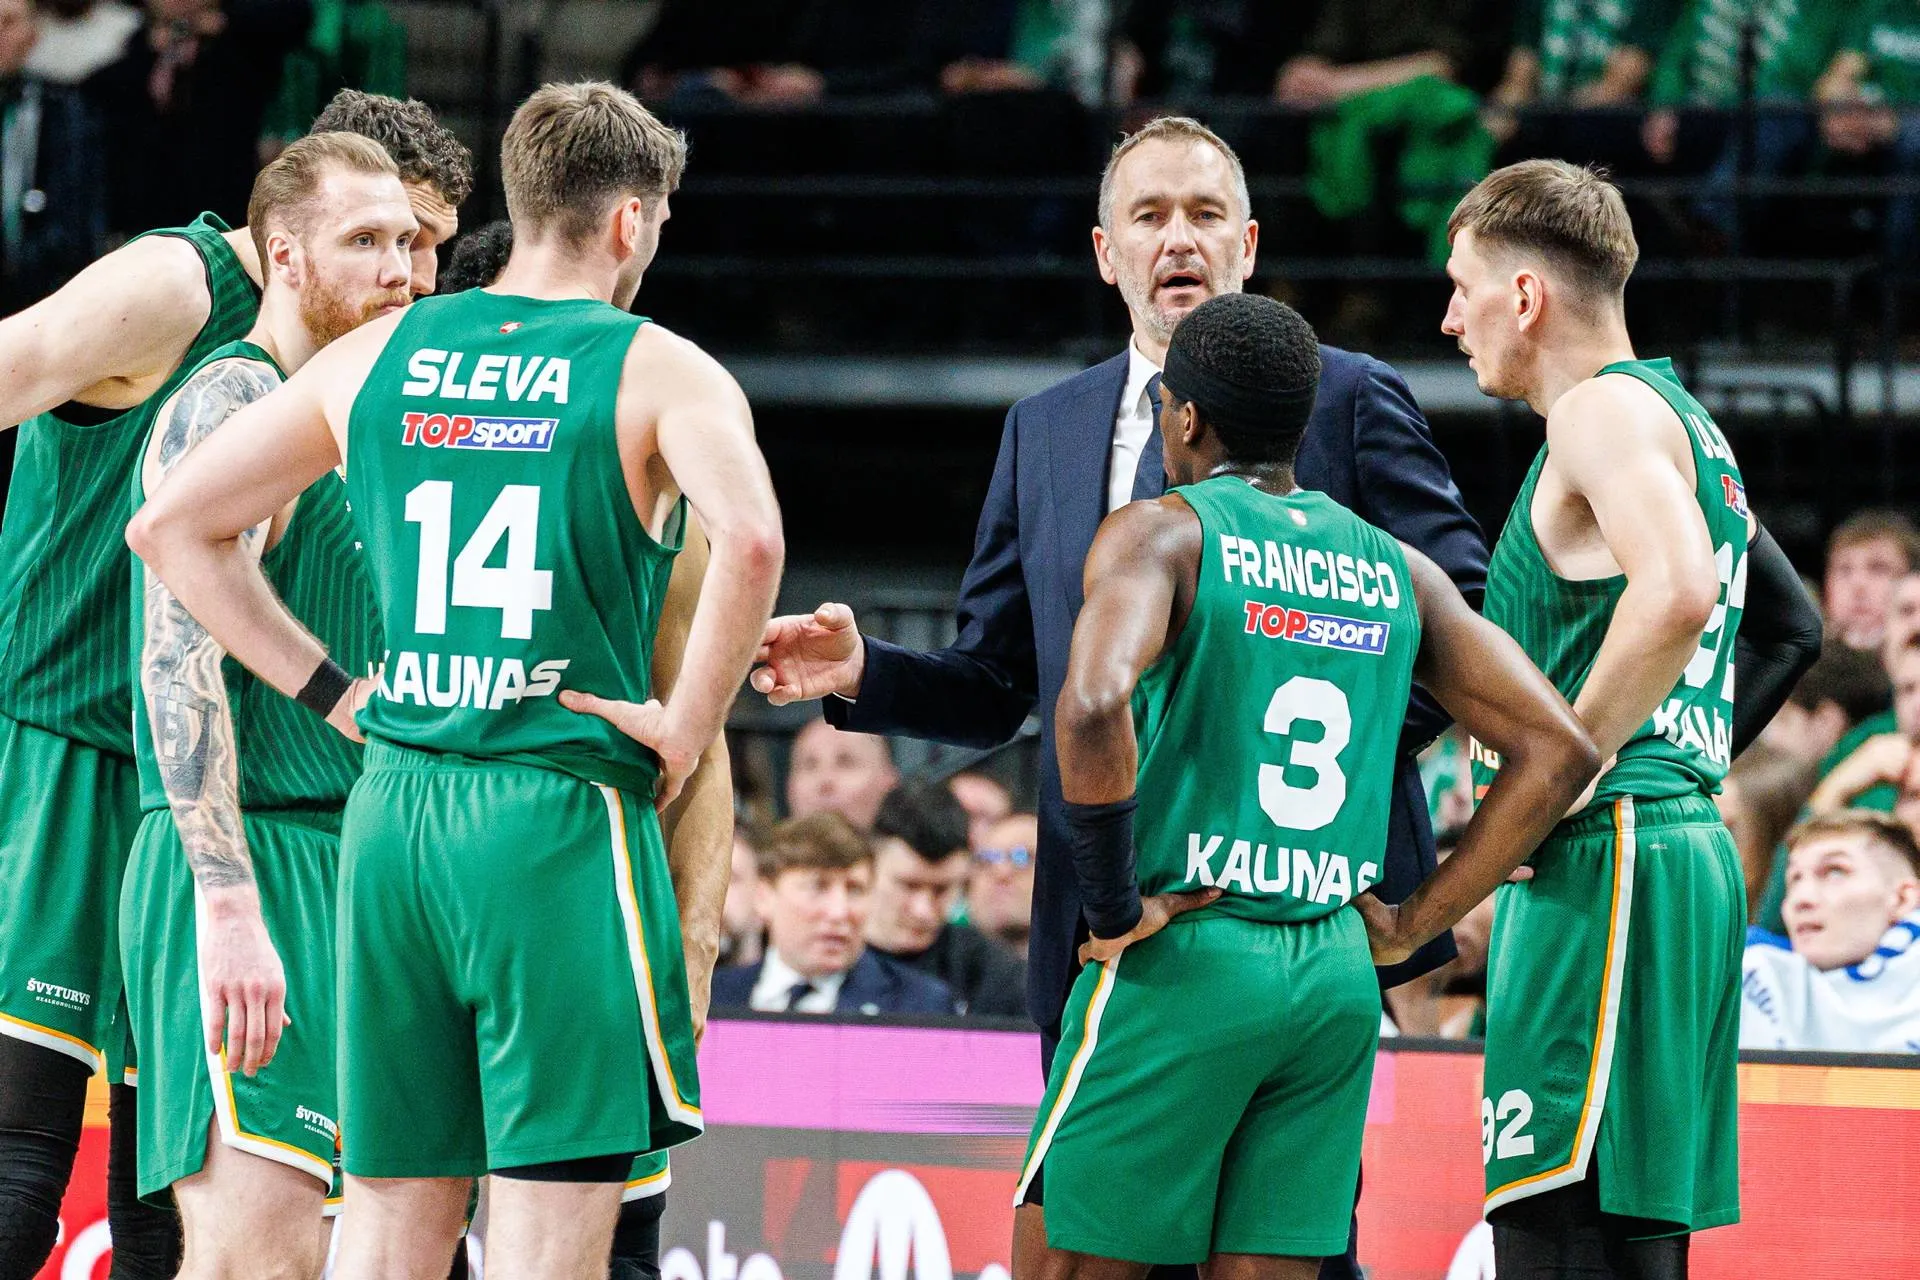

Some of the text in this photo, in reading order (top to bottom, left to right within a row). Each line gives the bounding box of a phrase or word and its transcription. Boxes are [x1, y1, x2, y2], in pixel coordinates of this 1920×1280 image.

[402, 348, 571, 404] SLEVA
[401, 412, 555, 450] TOPsport
[404, 480, 553, 639] 14
[1220, 533, 1400, 609] FRANCISCO
[1244, 600, 1385, 650] TOPsport
[1258, 675, 1352, 831] 3
[26, 977, 91, 1006] ŠVYTURYS
